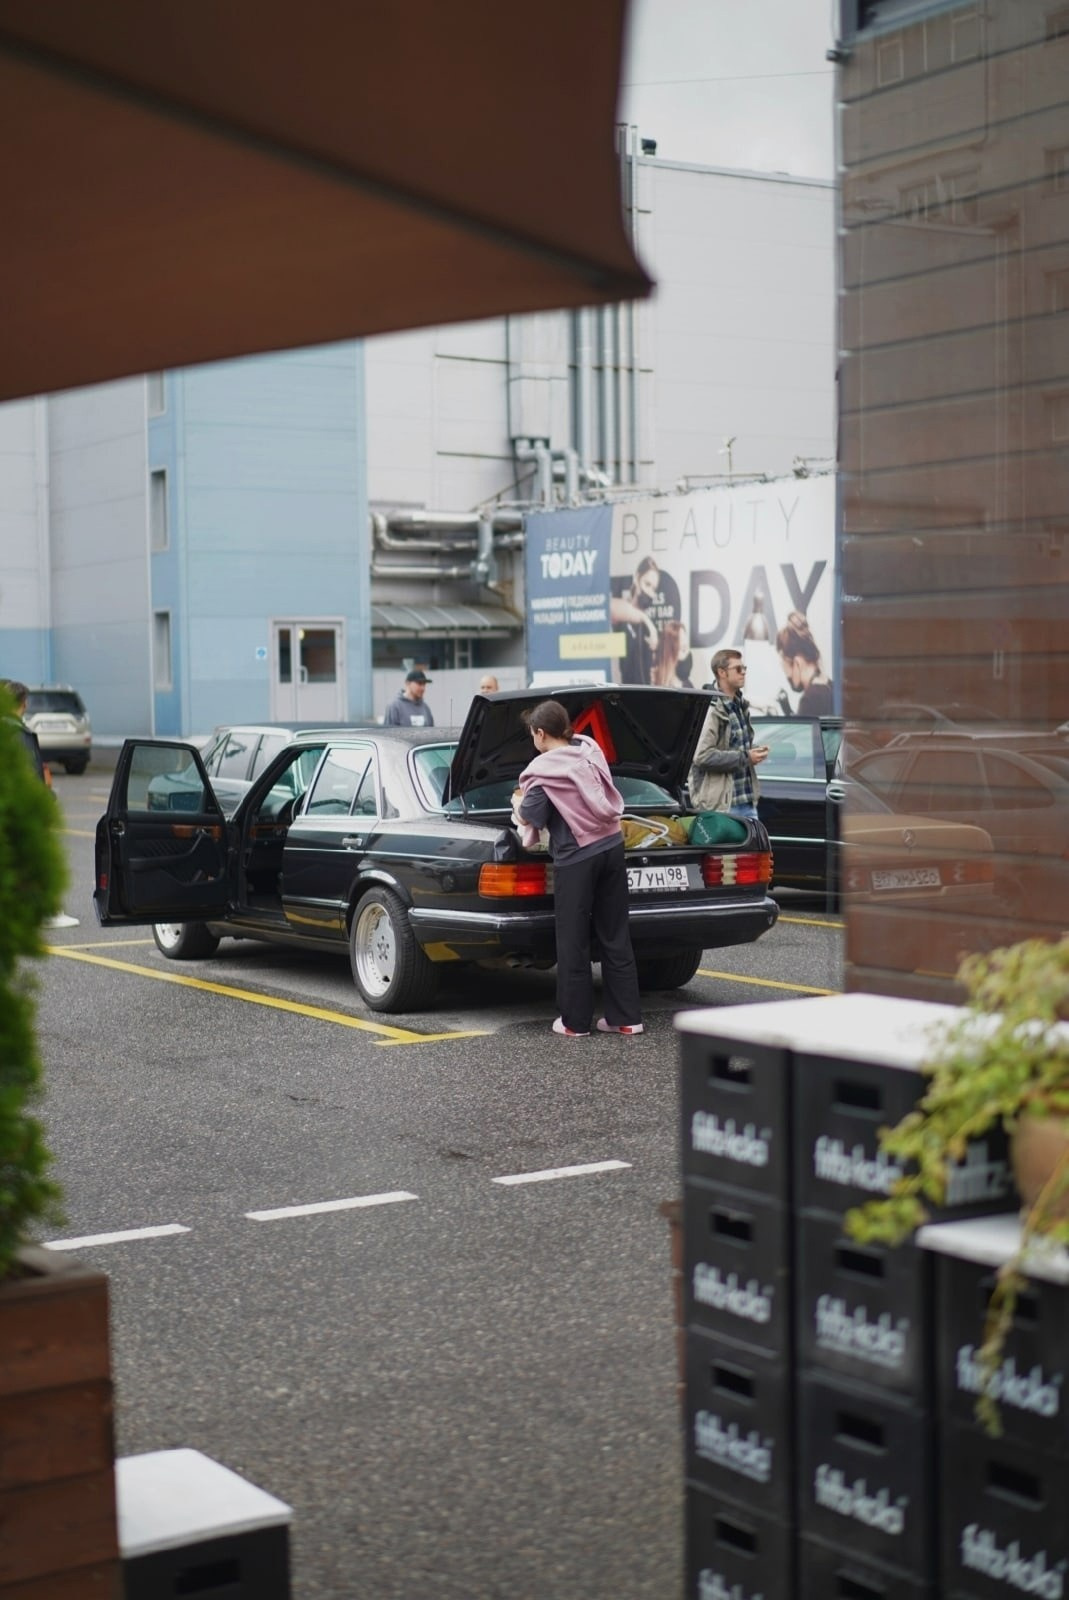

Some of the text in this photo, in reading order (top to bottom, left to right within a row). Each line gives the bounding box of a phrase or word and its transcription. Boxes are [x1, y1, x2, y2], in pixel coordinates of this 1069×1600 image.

[621, 496, 799, 554] BEAUTY
[545, 534, 590, 551] BEAUTY
[540, 549, 598, 579] TODAY
[667, 867, 683, 880] 98
